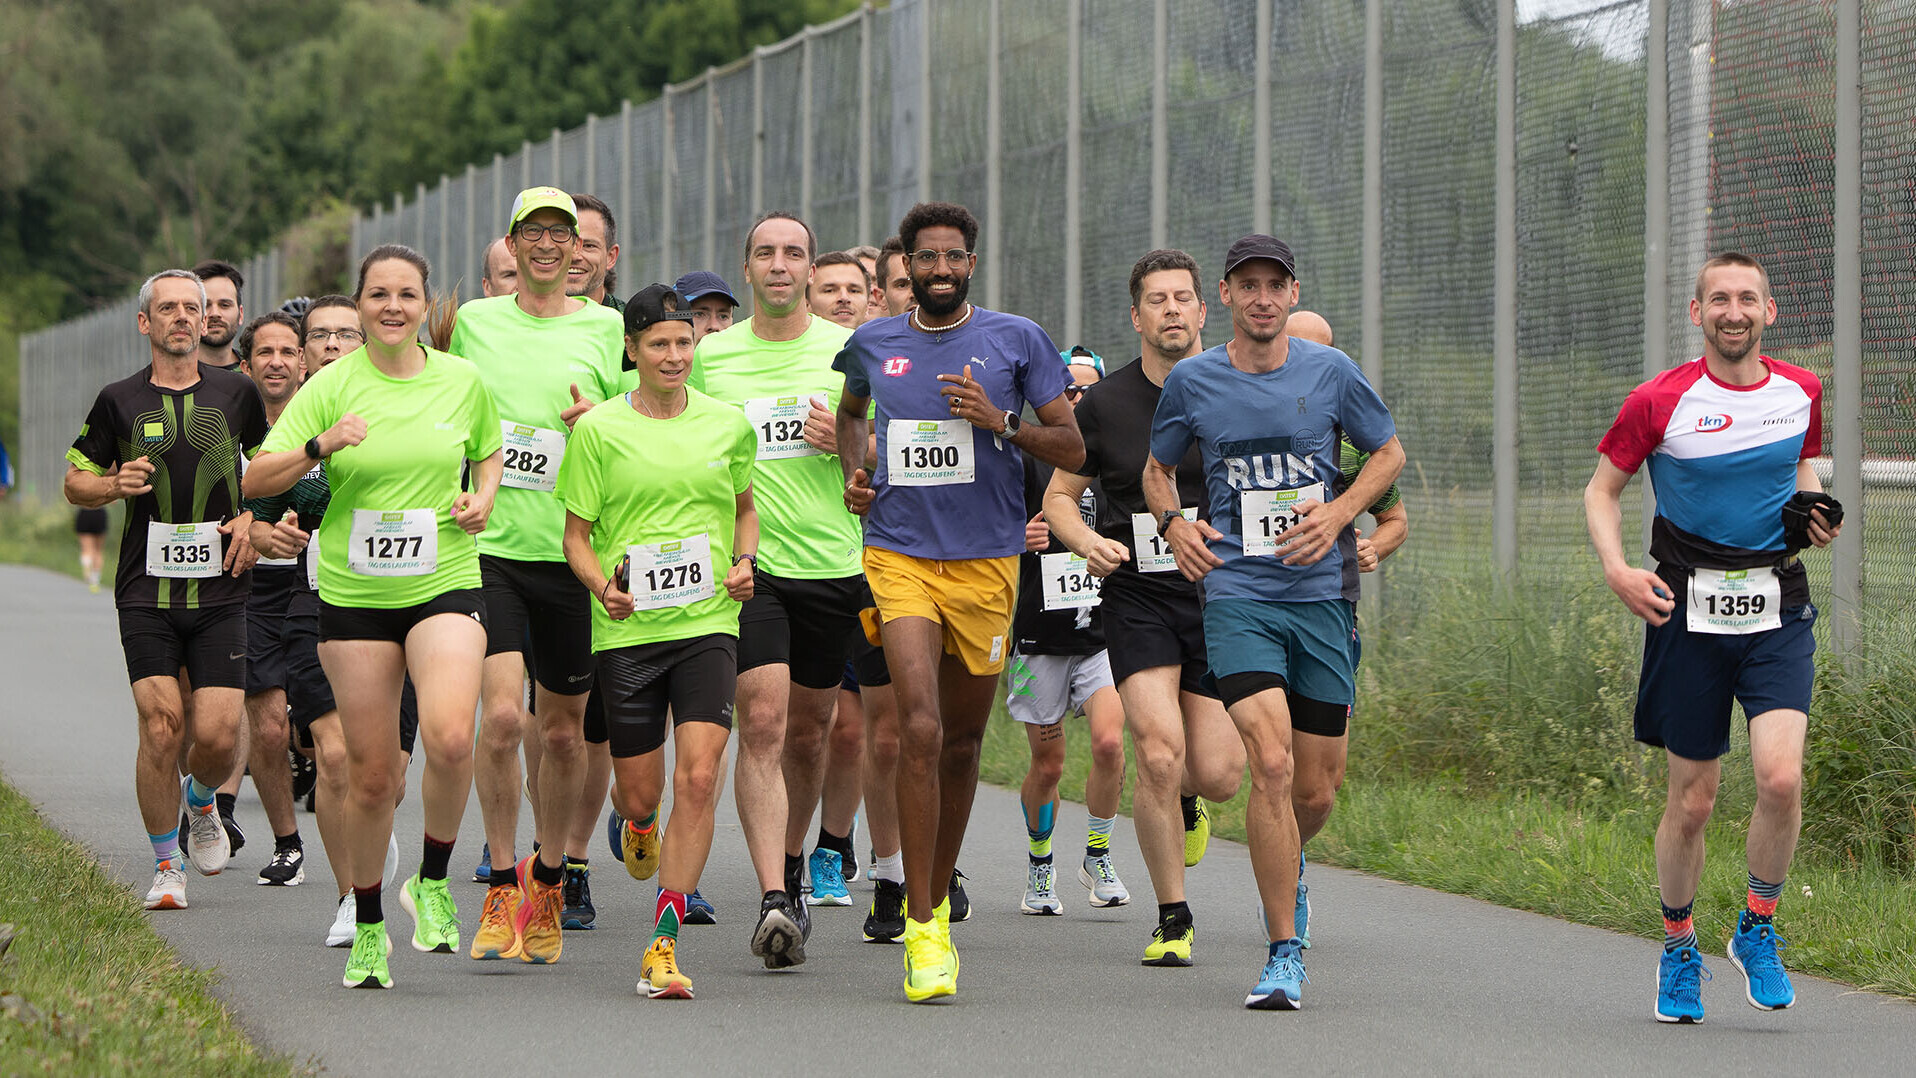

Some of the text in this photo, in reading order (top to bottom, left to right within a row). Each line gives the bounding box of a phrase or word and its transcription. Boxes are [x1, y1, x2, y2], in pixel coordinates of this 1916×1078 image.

[886, 358, 909, 374] LT
[762, 420, 806, 442] 132
[1698, 416, 1722, 426] tkn
[901, 446, 959, 468] 1300
[1223, 452, 1316, 489] RUN
[1259, 513, 1308, 537] 131
[161, 544, 210, 563] 1335
[365, 536, 423, 558] 1277
[645, 562, 702, 591] 1278
[676, 587, 700, 598] LAUFENS
[1705, 594, 1765, 616] 1359
